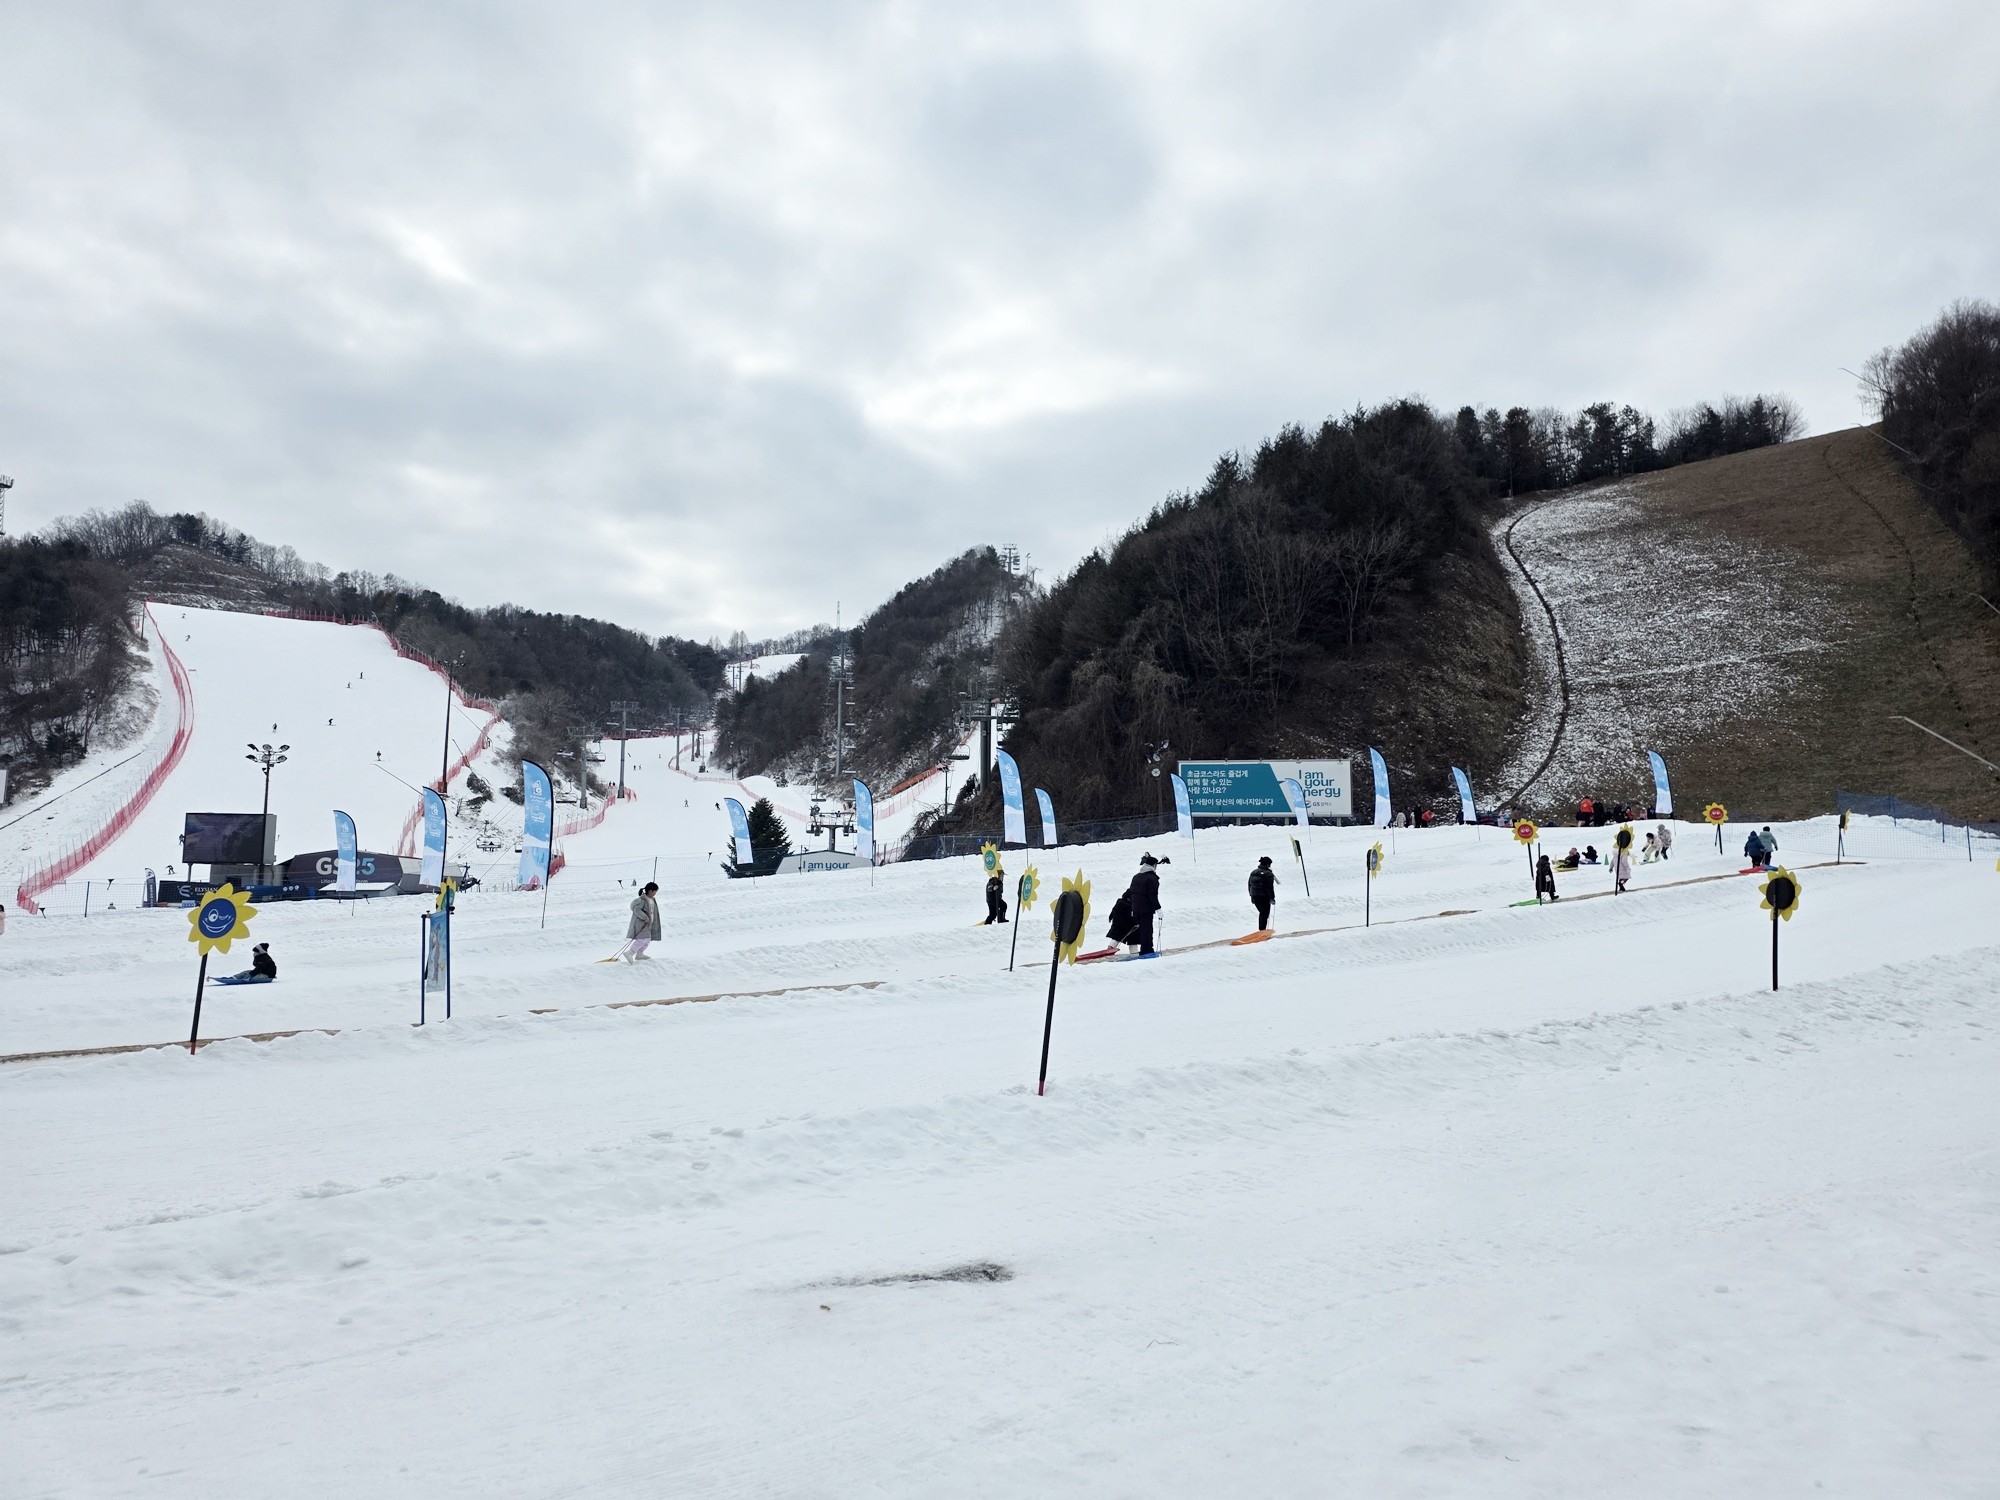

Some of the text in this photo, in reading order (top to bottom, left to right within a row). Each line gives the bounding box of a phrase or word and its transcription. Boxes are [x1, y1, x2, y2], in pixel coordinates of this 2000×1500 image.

[1304, 779, 1334, 788] your
[1304, 788, 1340, 797] nergy
[316, 857, 375, 876] G5
[825, 862, 850, 871] your
